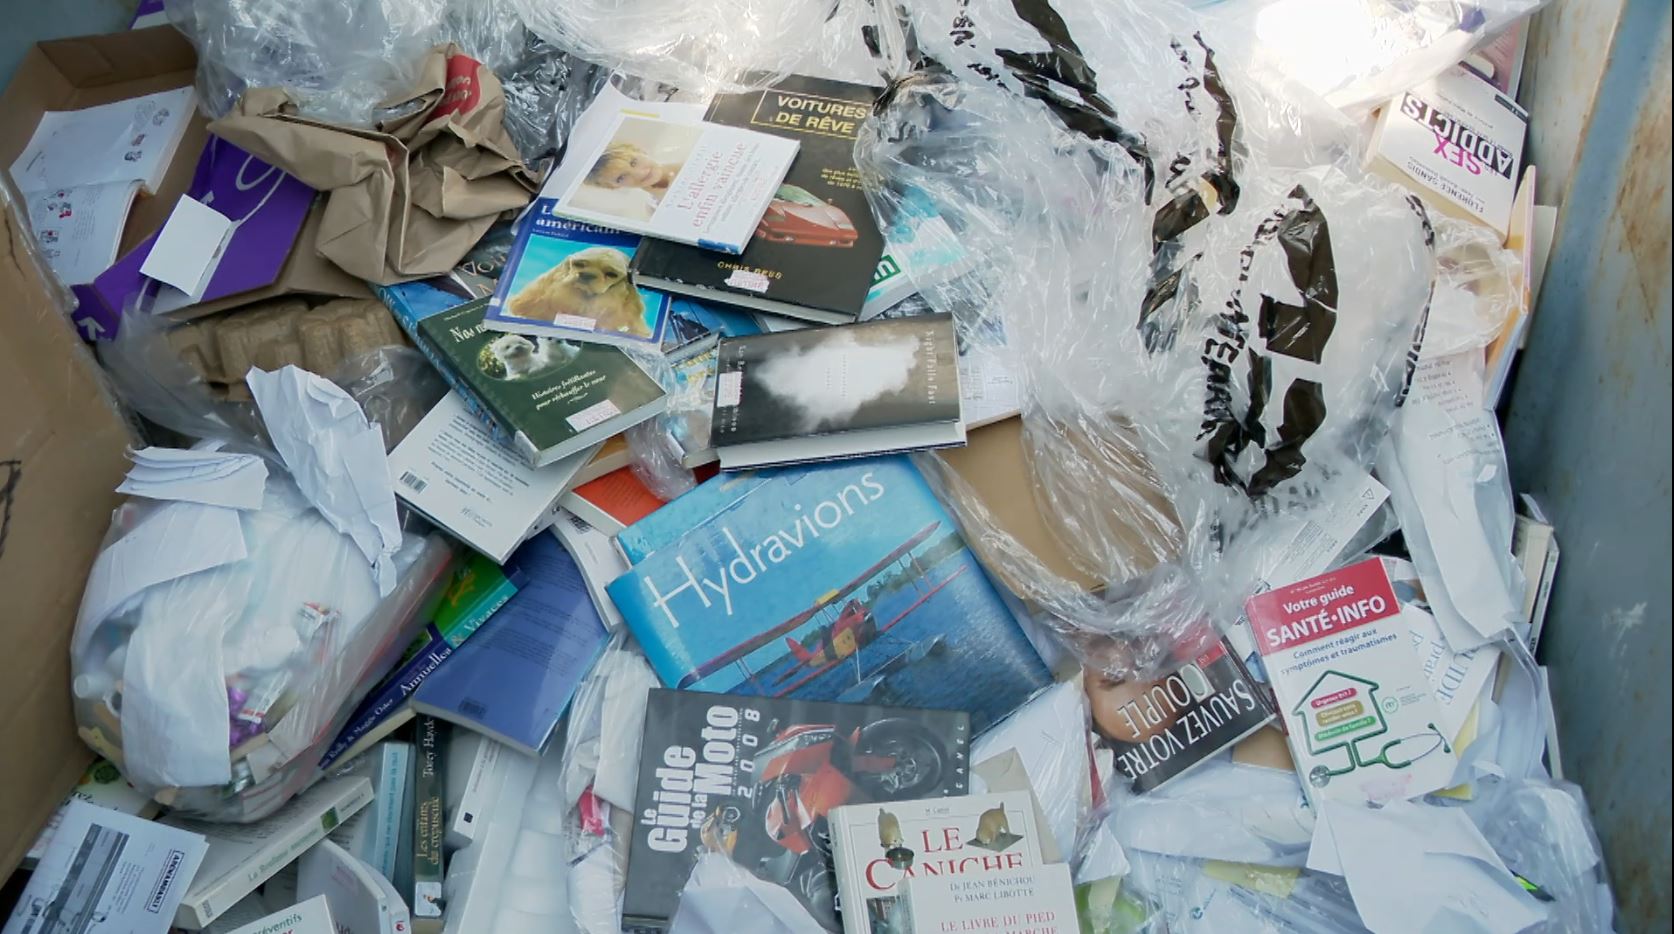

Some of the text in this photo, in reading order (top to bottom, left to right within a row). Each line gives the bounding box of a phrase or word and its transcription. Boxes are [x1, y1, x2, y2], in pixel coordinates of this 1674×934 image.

[775, 111, 856, 134] DE RÊVE
[777, 95, 868, 120] VOITURES
[1401, 92, 1514, 180] ADDICTS
[1432, 134, 1482, 176] SEX
[677, 151, 723, 210] L'allergie
[693, 194, 718, 228] enfin
[713, 142, 748, 191] vaincue
[717, 260, 750, 273] CHRIS
[450, 325, 475, 344] Nos
[927, 358, 938, 382] Falls
[927, 384, 938, 406] Fast
[643, 470, 885, 628] Hydravions
[464, 594, 509, 633] Vivaces
[1282, 594, 1318, 615] Votre
[1320, 585, 1354, 606] guide
[1280, 654, 1330, 676] symptômes
[1331, 650, 1339, 659] et
[1339, 632, 1398, 655] traumatismes
[1293, 628, 1378, 660] Comment réagir aux
[400, 648, 453, 696] Annuelles
[1436, 649, 1475, 706] UIDE
[1116, 660, 1211, 739] COUPLE
[1117, 679, 1256, 780] SAUVEZ VOTRE
[693, 705, 739, 796] Moto
[737, 708, 761, 799] 2008
[641, 808, 657, 825] Le
[647, 745, 697, 853] Guide
[691, 794, 708, 808] la
[416, 801, 429, 857] Les enfants
[922, 828, 963, 853] LE
[963, 879, 985, 891] JEAN
[988, 876, 1034, 887] BÉNICHOU
[965, 891, 991, 902] MARC
[994, 888, 1034, 899] LIBOTTE
[941, 921, 958, 931] LE
[962, 916, 999, 930] LIVRE
[1026, 911, 1055, 923] PIED
